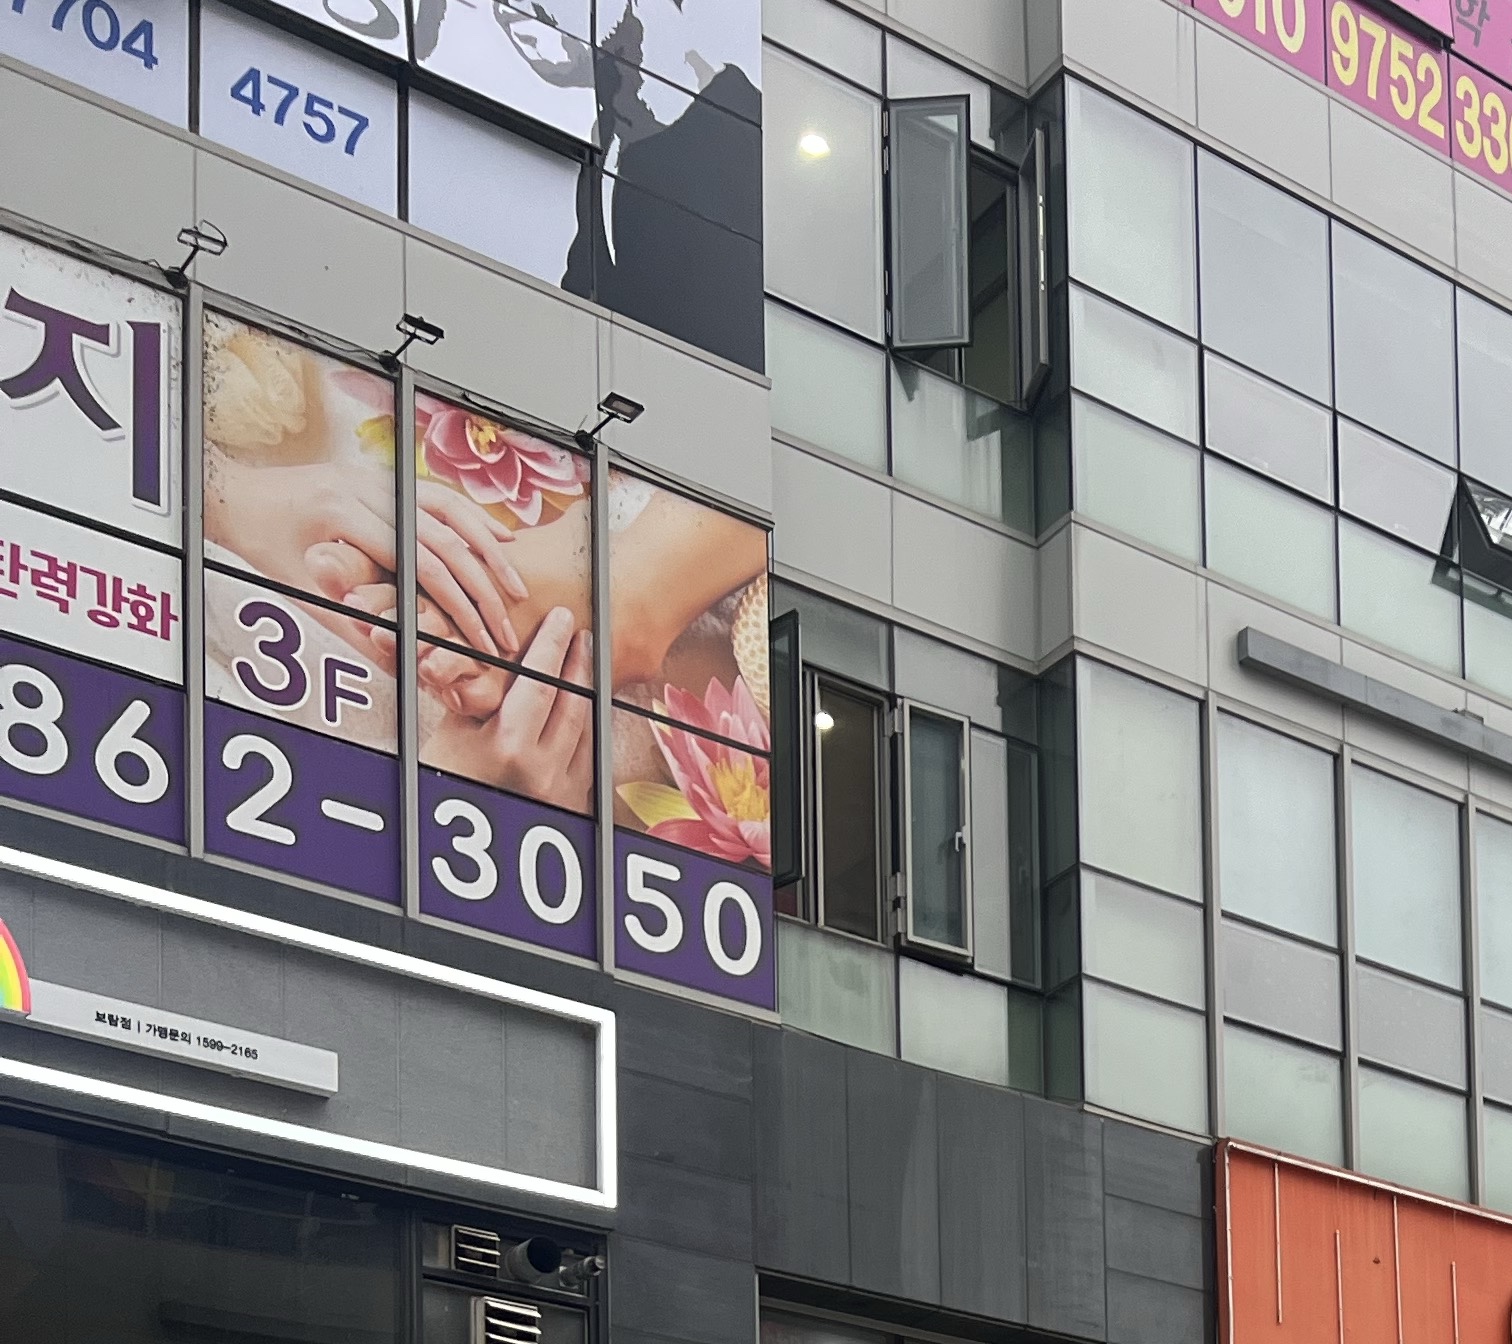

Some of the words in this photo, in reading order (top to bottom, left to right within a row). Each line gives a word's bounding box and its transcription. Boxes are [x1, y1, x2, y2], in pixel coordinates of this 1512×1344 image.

[11, 0, 158, 70] 704
[230, 66, 369, 156] 4757
[1331, 0, 1445, 139] 9752
[234, 601, 372, 725] 3F
[95, 1010, 132, 1031] 보람점
[145, 1023, 191, 1045] 가맹문의
[196, 1036, 258, 1060] 1599-2165
